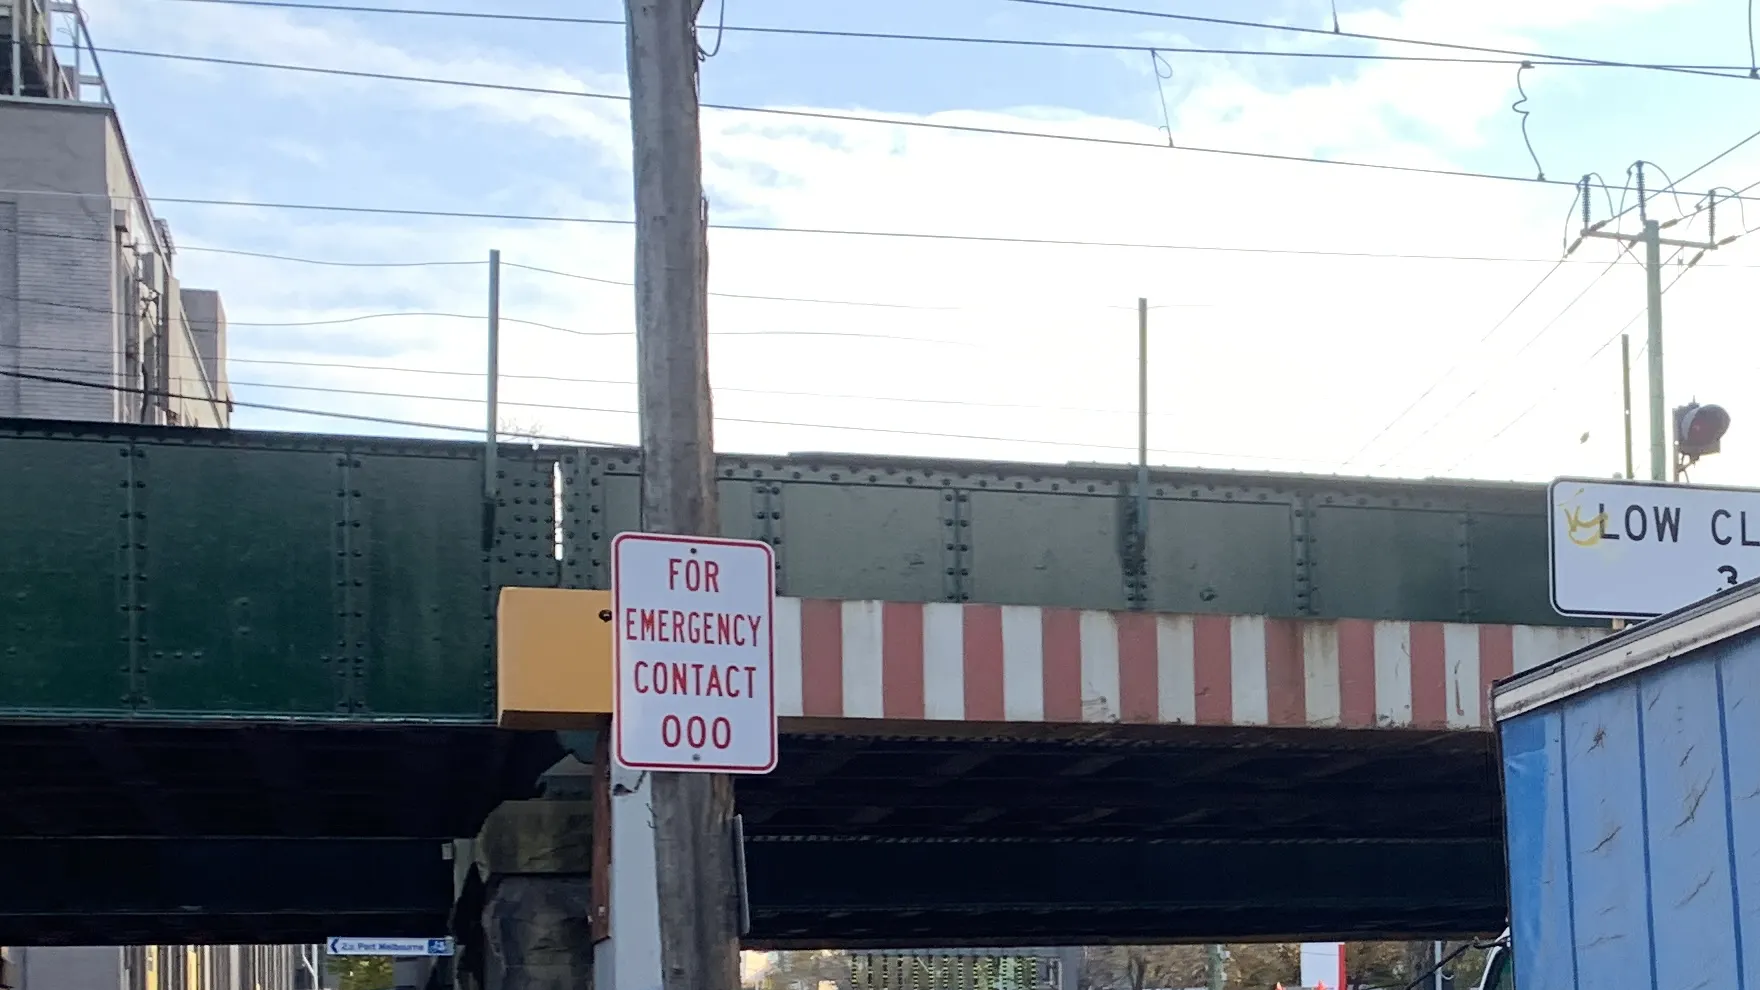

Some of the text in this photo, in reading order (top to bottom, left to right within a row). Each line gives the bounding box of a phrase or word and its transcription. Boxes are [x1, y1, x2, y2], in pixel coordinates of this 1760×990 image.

[1599, 502, 1681, 543] LOW
[668, 558, 719, 593] FOR
[626, 607, 762, 647] EMERGENCY
[634, 660, 757, 698] CONTACT
[378, 942, 425, 951] Melbourne
